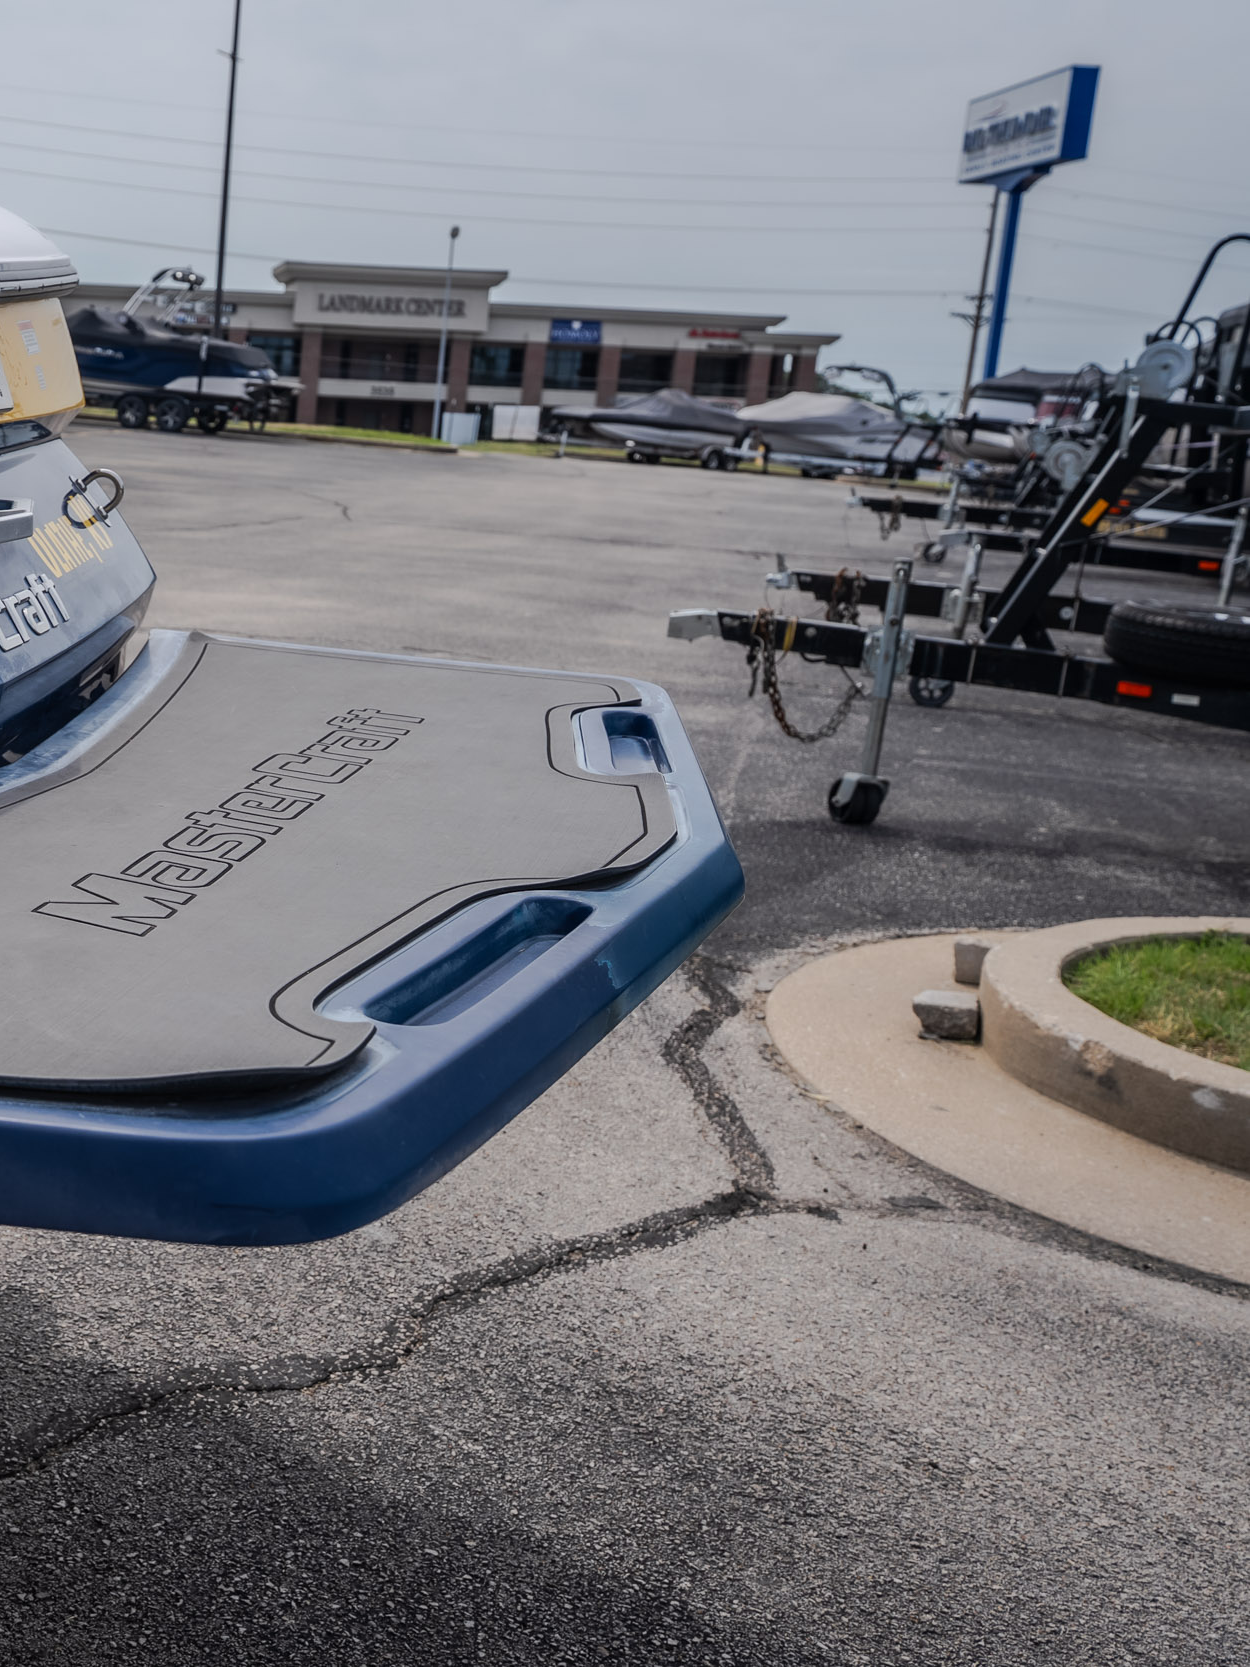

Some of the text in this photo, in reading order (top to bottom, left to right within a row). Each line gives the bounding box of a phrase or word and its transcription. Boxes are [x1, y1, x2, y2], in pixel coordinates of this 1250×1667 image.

[317, 293, 468, 318] LANDMARK CENTER
[31, 708, 426, 937] MasterCraft
